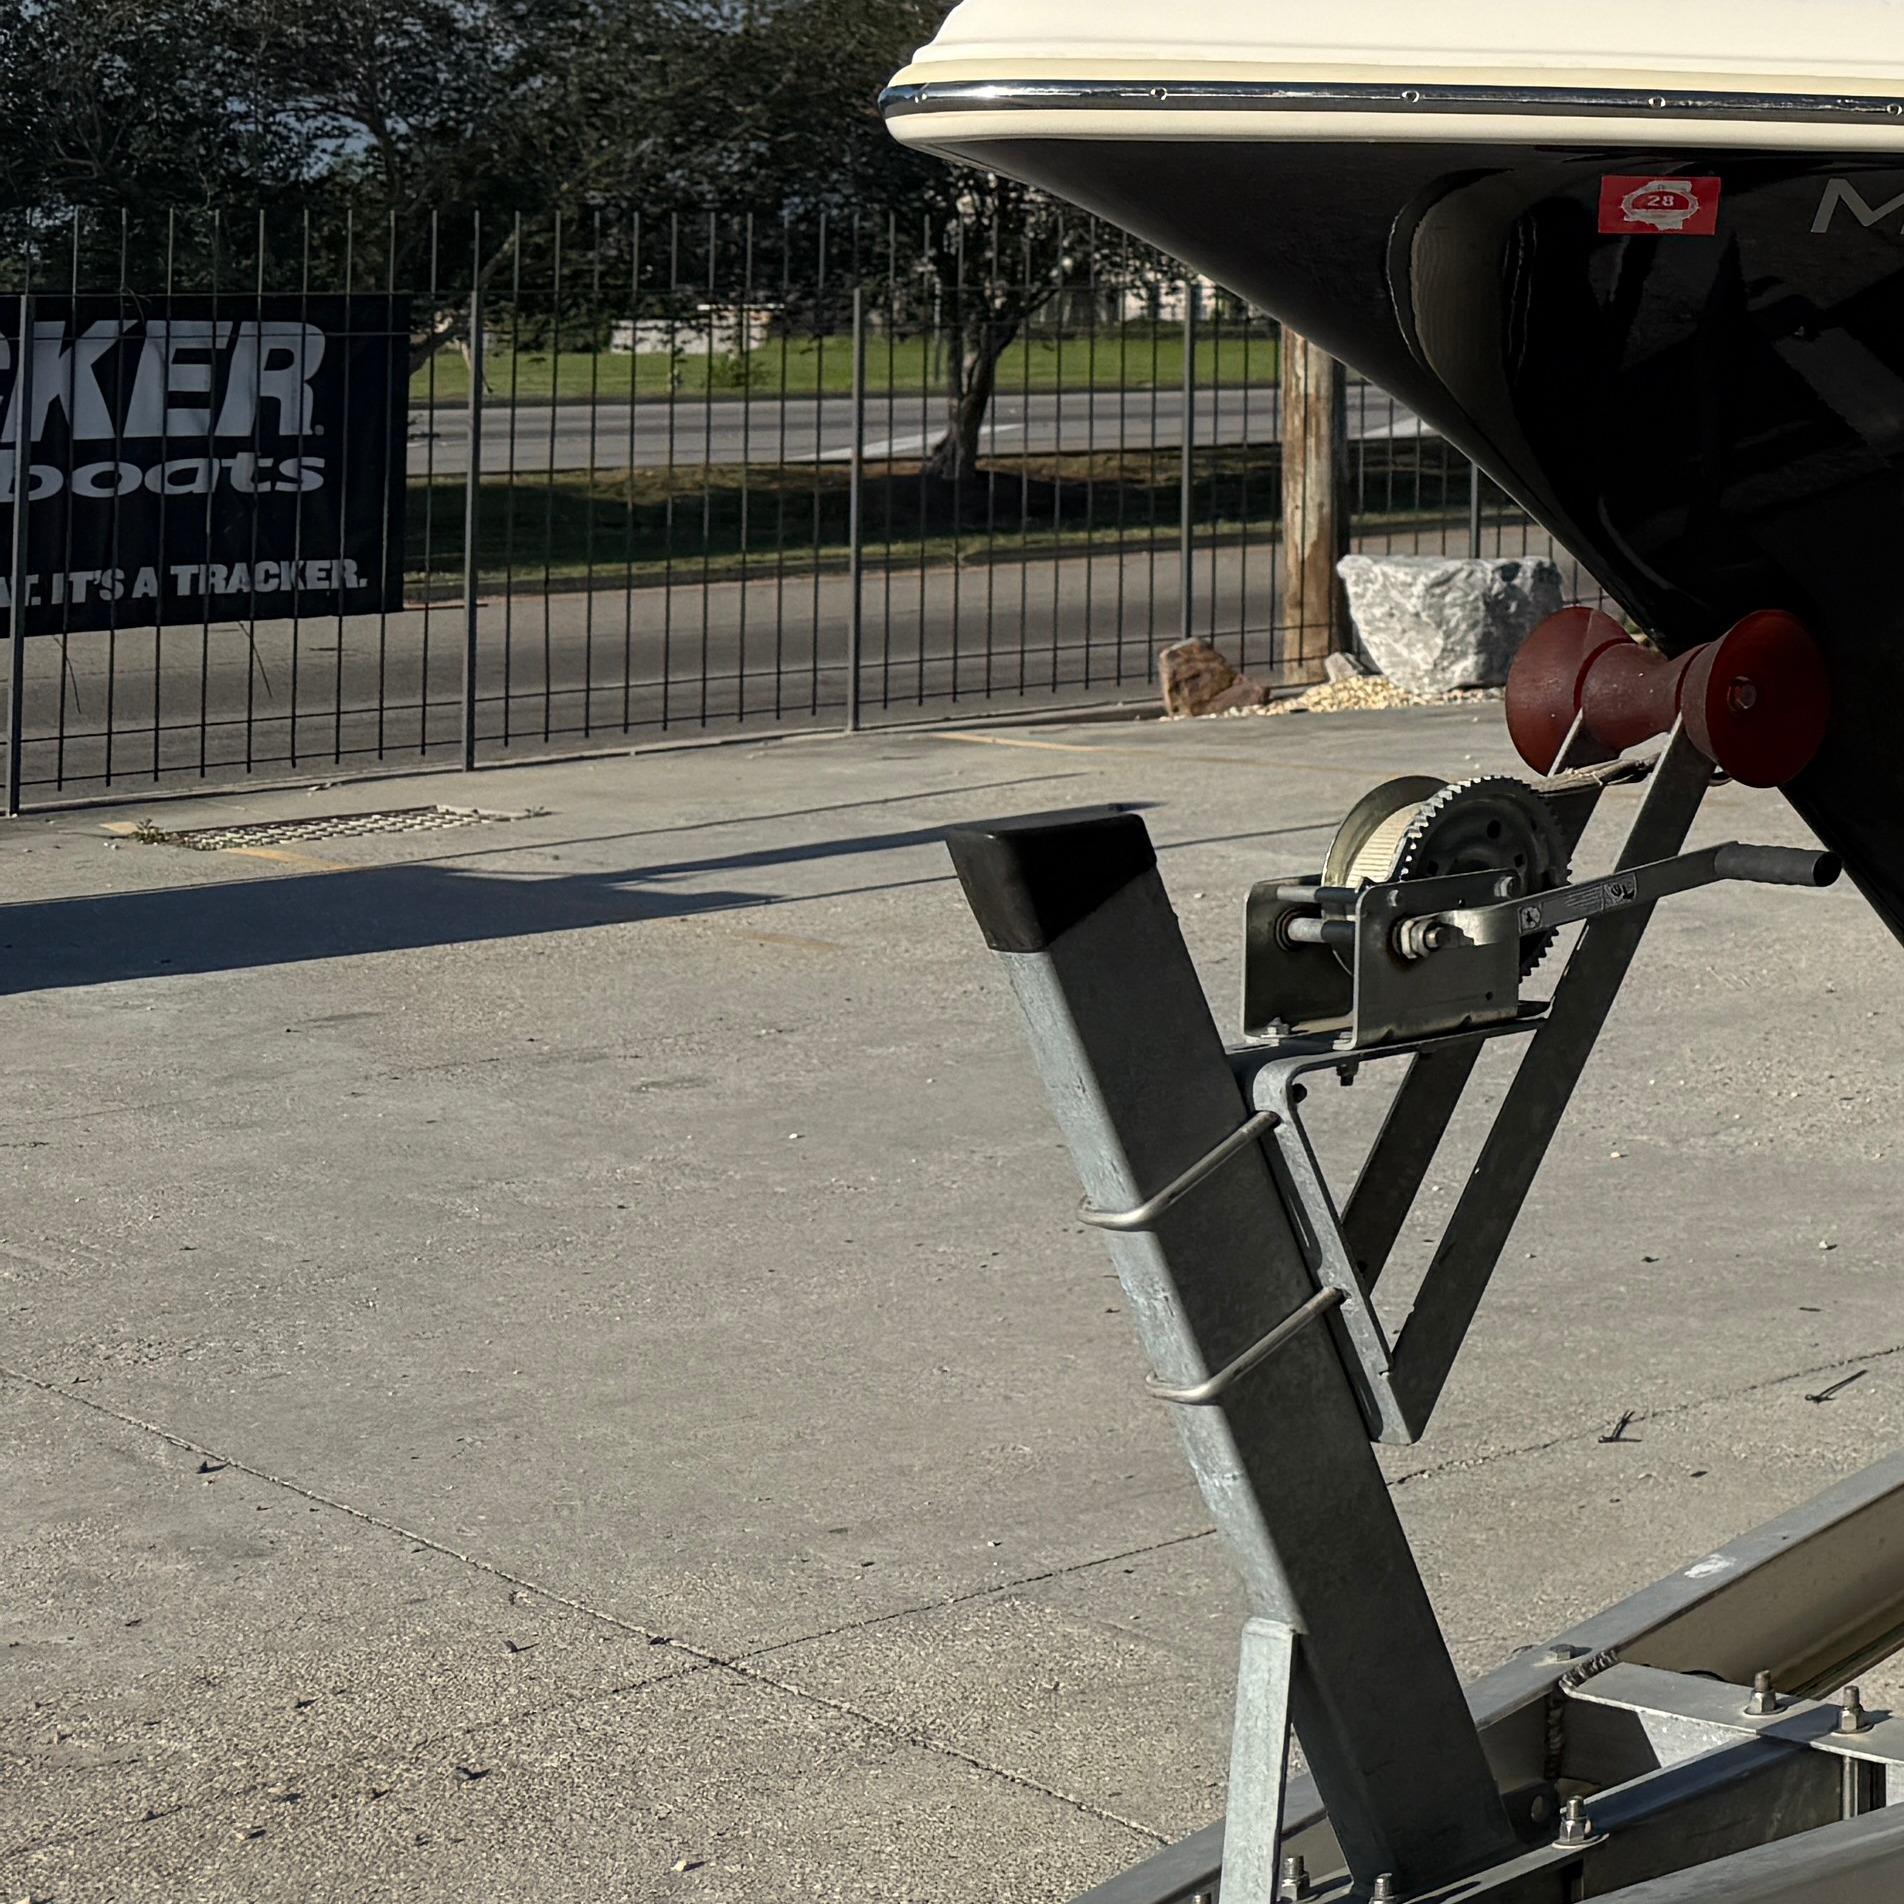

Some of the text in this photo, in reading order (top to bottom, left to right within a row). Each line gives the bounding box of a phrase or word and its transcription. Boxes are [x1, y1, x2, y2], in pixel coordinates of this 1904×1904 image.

[0, 320, 326, 442] KER
[51, 567, 126, 605] IT'S
[132, 566, 158, 599] A
[170, 559, 368, 596] TRACKER.
